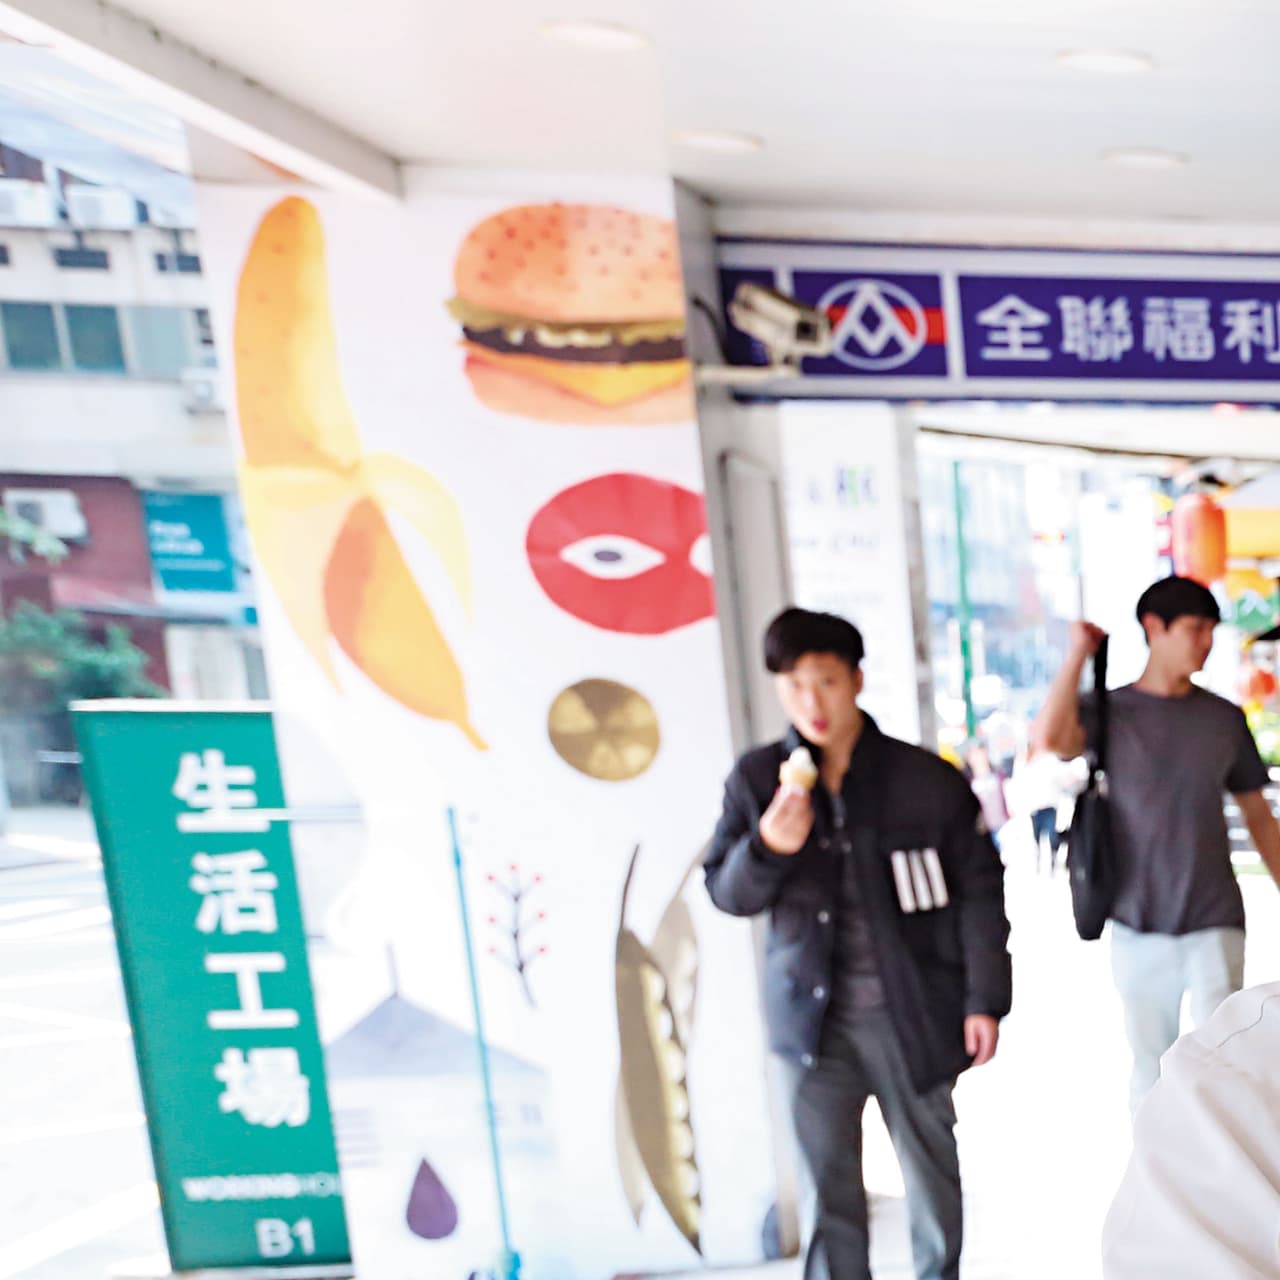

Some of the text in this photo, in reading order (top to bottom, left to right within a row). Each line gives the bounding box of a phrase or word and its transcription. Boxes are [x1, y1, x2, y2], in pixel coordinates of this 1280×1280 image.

[172, 749, 310, 1128] 生活工場
[255, 1218, 316, 1258] B1
